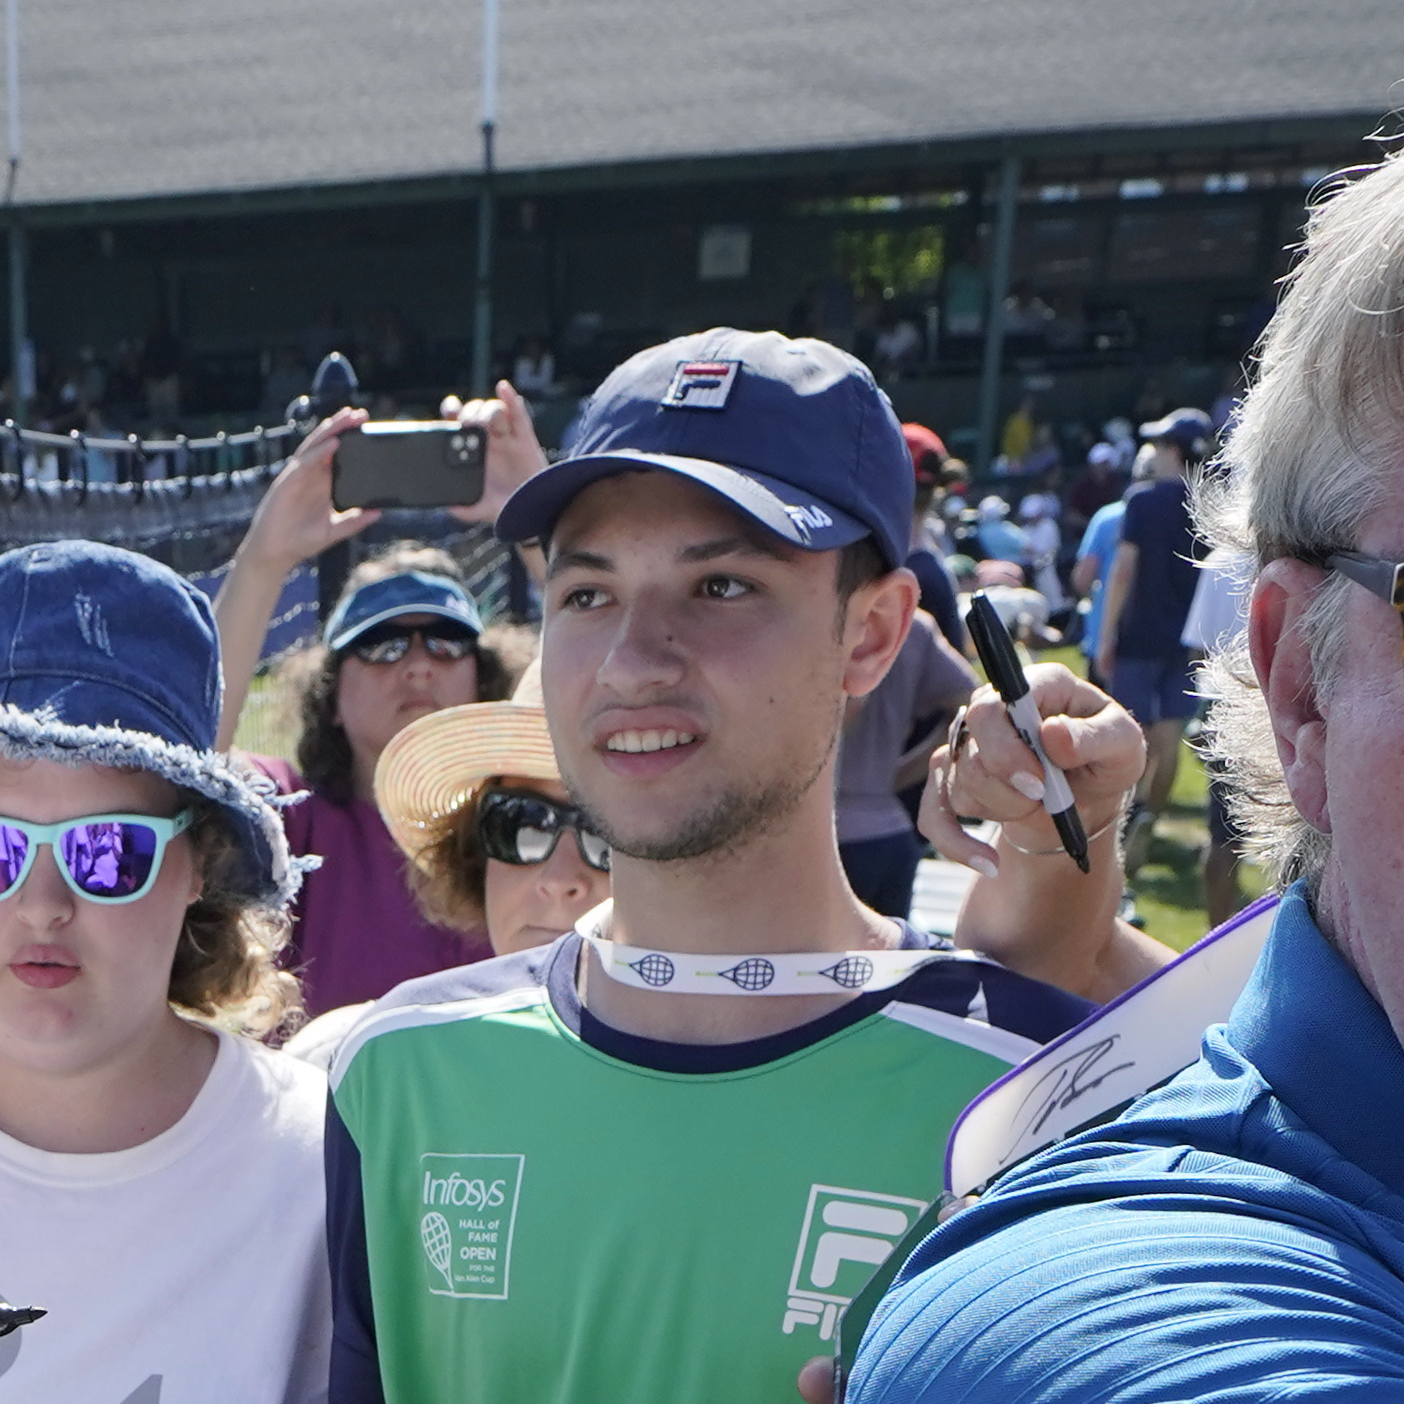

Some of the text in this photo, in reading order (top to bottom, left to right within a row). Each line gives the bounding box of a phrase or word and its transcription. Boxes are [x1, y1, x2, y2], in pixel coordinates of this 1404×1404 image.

[422, 1170, 507, 1213] Infosys
[458, 1218, 501, 1230] HALL of
[467, 1231, 499, 1244] FAME
[459, 1245, 497, 1261] OPEN
[782, 1297, 847, 1341] FI
